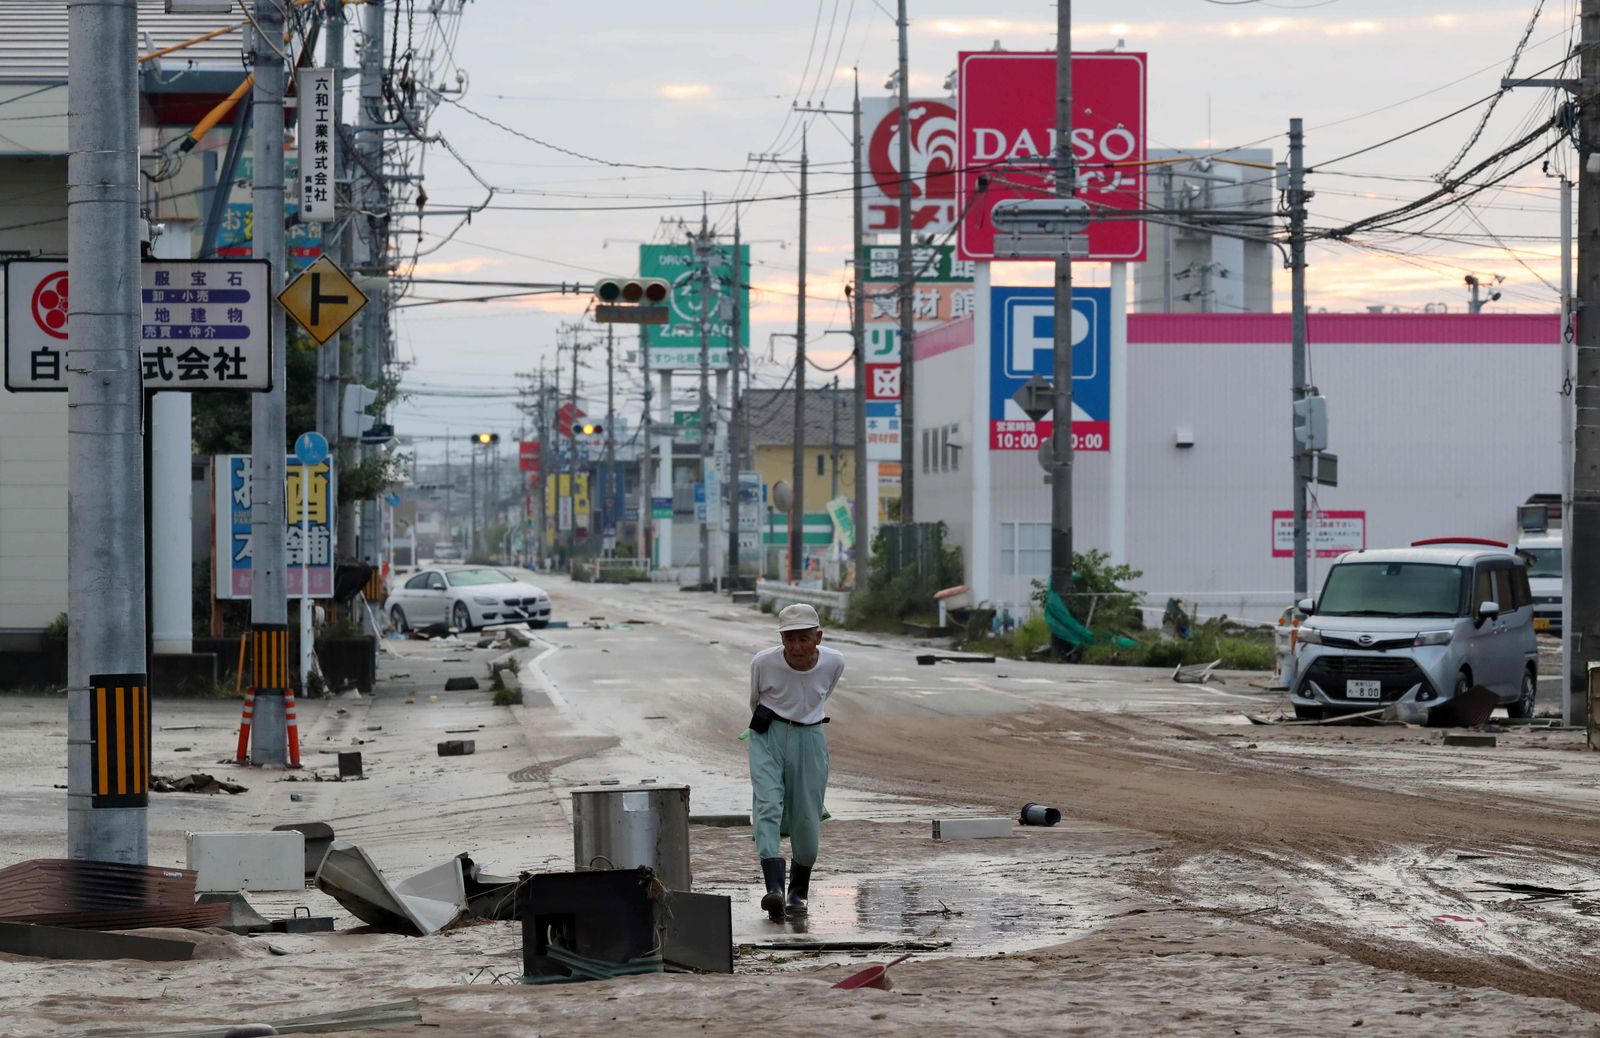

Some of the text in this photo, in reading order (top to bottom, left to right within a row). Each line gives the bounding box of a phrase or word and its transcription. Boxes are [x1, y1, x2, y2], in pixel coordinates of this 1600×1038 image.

[314, 78, 329, 202] 六和工業株式会社
[996, 433, 1103, 448] 10:00 0:00
